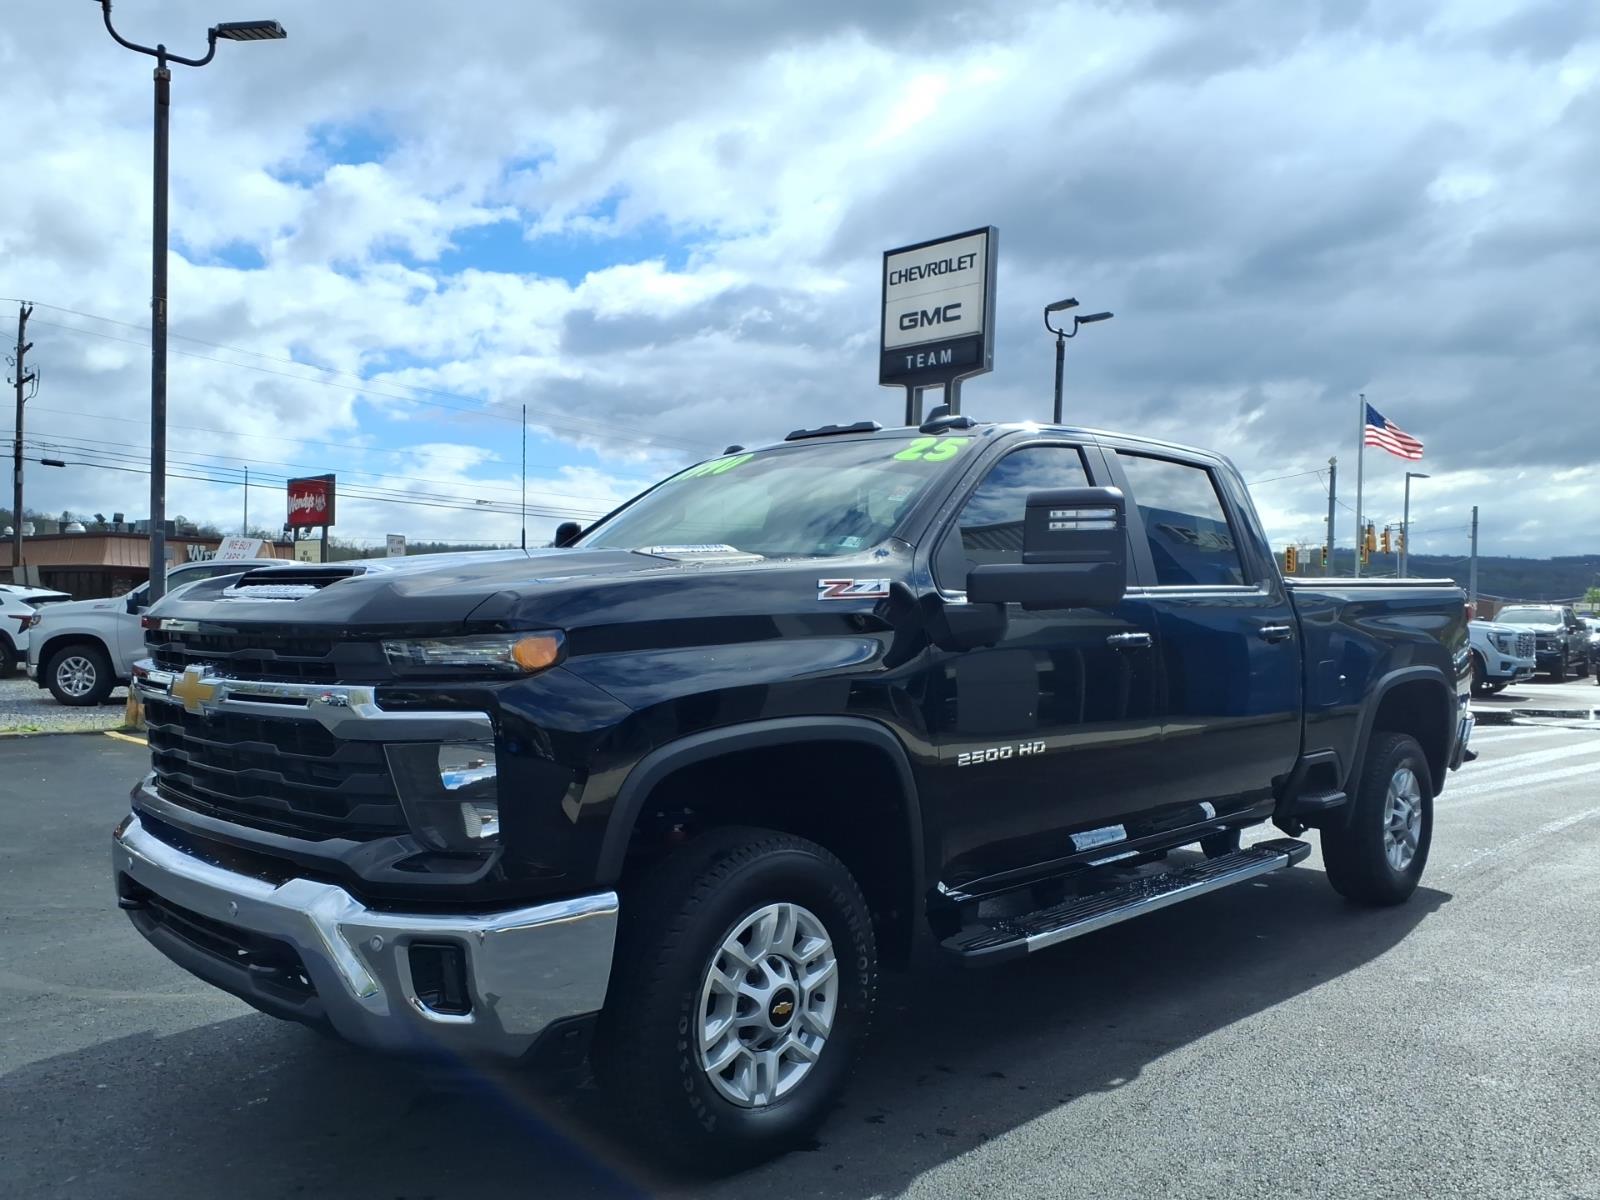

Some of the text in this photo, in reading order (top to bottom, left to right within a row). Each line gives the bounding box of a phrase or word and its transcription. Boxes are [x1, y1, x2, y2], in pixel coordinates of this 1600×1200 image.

[889, 253, 977, 286] CHEVROLET
[899, 302, 962, 331] GMC
[906, 348, 952, 369] TEAM
[894, 437, 969, 461] 25
[288, 491, 315, 513] Wendy's
[817, 579, 891, 601] Z71
[958, 741, 1046, 767] 2500 HD
